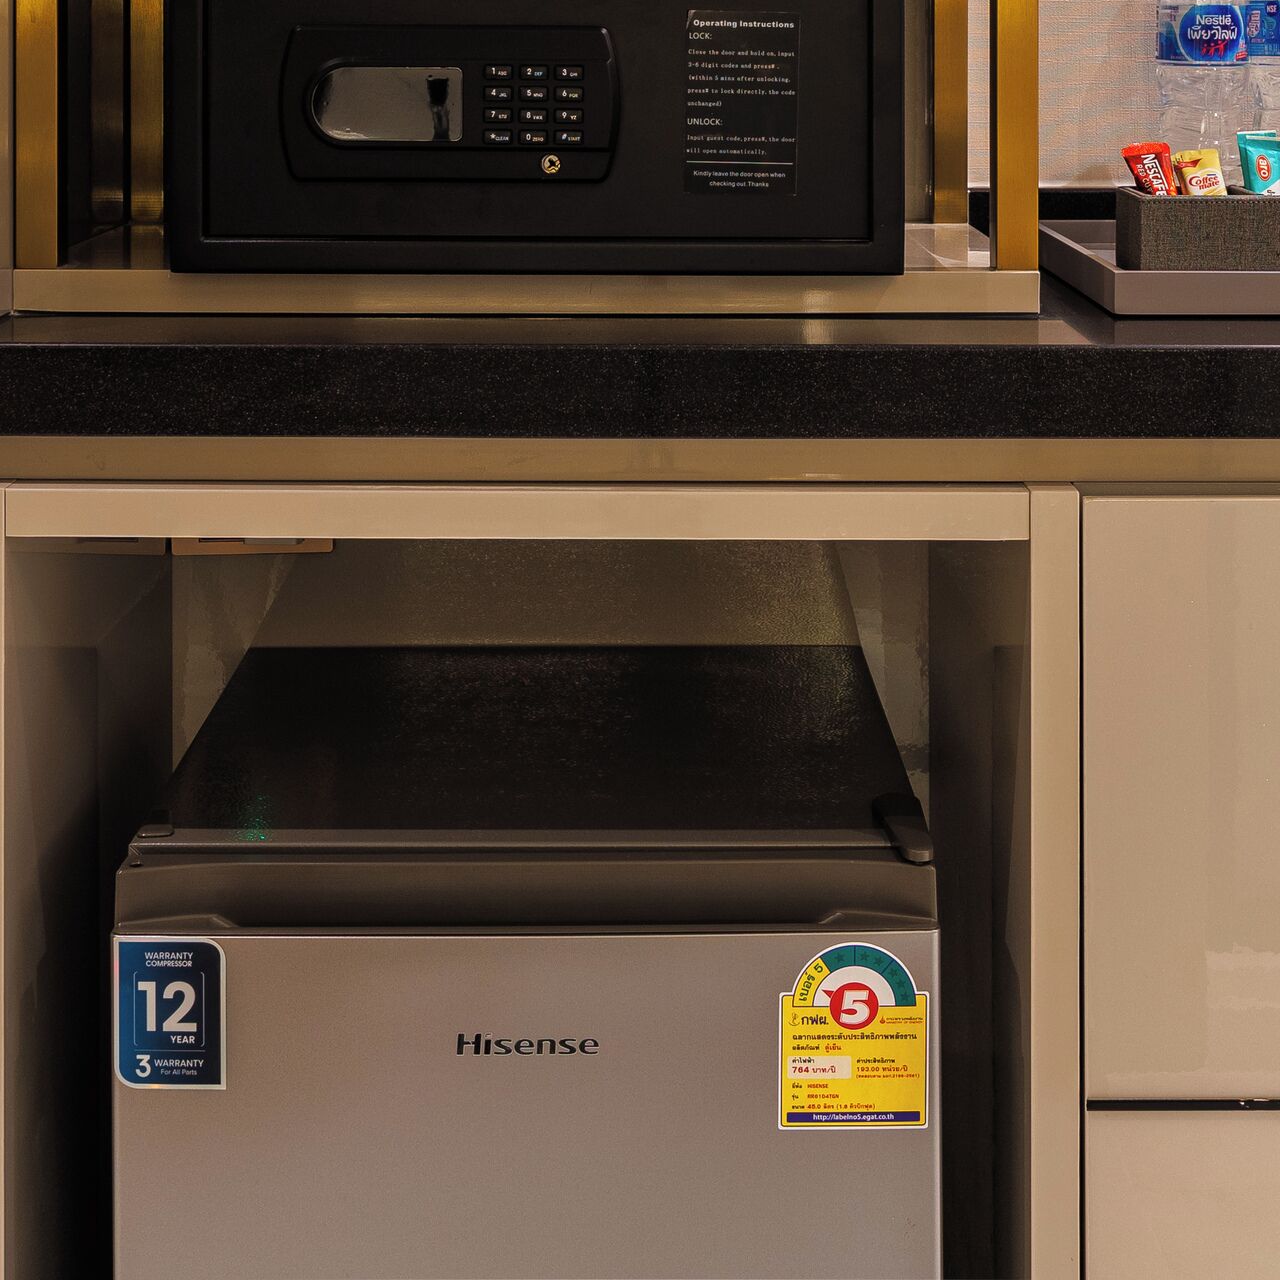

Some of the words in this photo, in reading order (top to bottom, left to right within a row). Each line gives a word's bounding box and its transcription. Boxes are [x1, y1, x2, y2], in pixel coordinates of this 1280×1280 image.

[693, 19, 738, 28] Operating
[739, 20, 795, 28] Instructions
[689, 32, 713, 40] LOCK:
[491, 67, 496, 75] 1
[526, 67, 532, 76] 2
[562, 68, 567, 76] 3
[491, 88, 496, 96] 4
[526, 89, 532, 97] 5
[562, 89, 567, 97] 6
[490, 110, 496, 118] 7
[526, 111, 531, 119] 8
[561, 111, 567, 119] 9
[687, 118, 723, 126] UNLOCK:
[526, 133, 531, 141] 0
[693, 170, 712, 178] Kindly
[1136, 164, 1146, 177] RED
[1188, 175, 1219, 187] Coffee
[1199, 180, 1220, 190] mate
[144, 952, 193, 960] WARRANTY
[799, 971, 816, 1002] เบอร์
[813, 963, 824, 973] 5
[137, 980, 197, 1032] 12
[839, 989, 871, 1025] 5
[170, 1035, 196, 1044] YEAR
[456, 1033, 600, 1055] Hisense
[135, 1054, 151, 1078] 3
[154, 1059, 204, 1067] WARRANTY
[792, 1066, 810, 1074] 764
[813, 1113, 895, 1122] http://labelno5.egat.co.th
